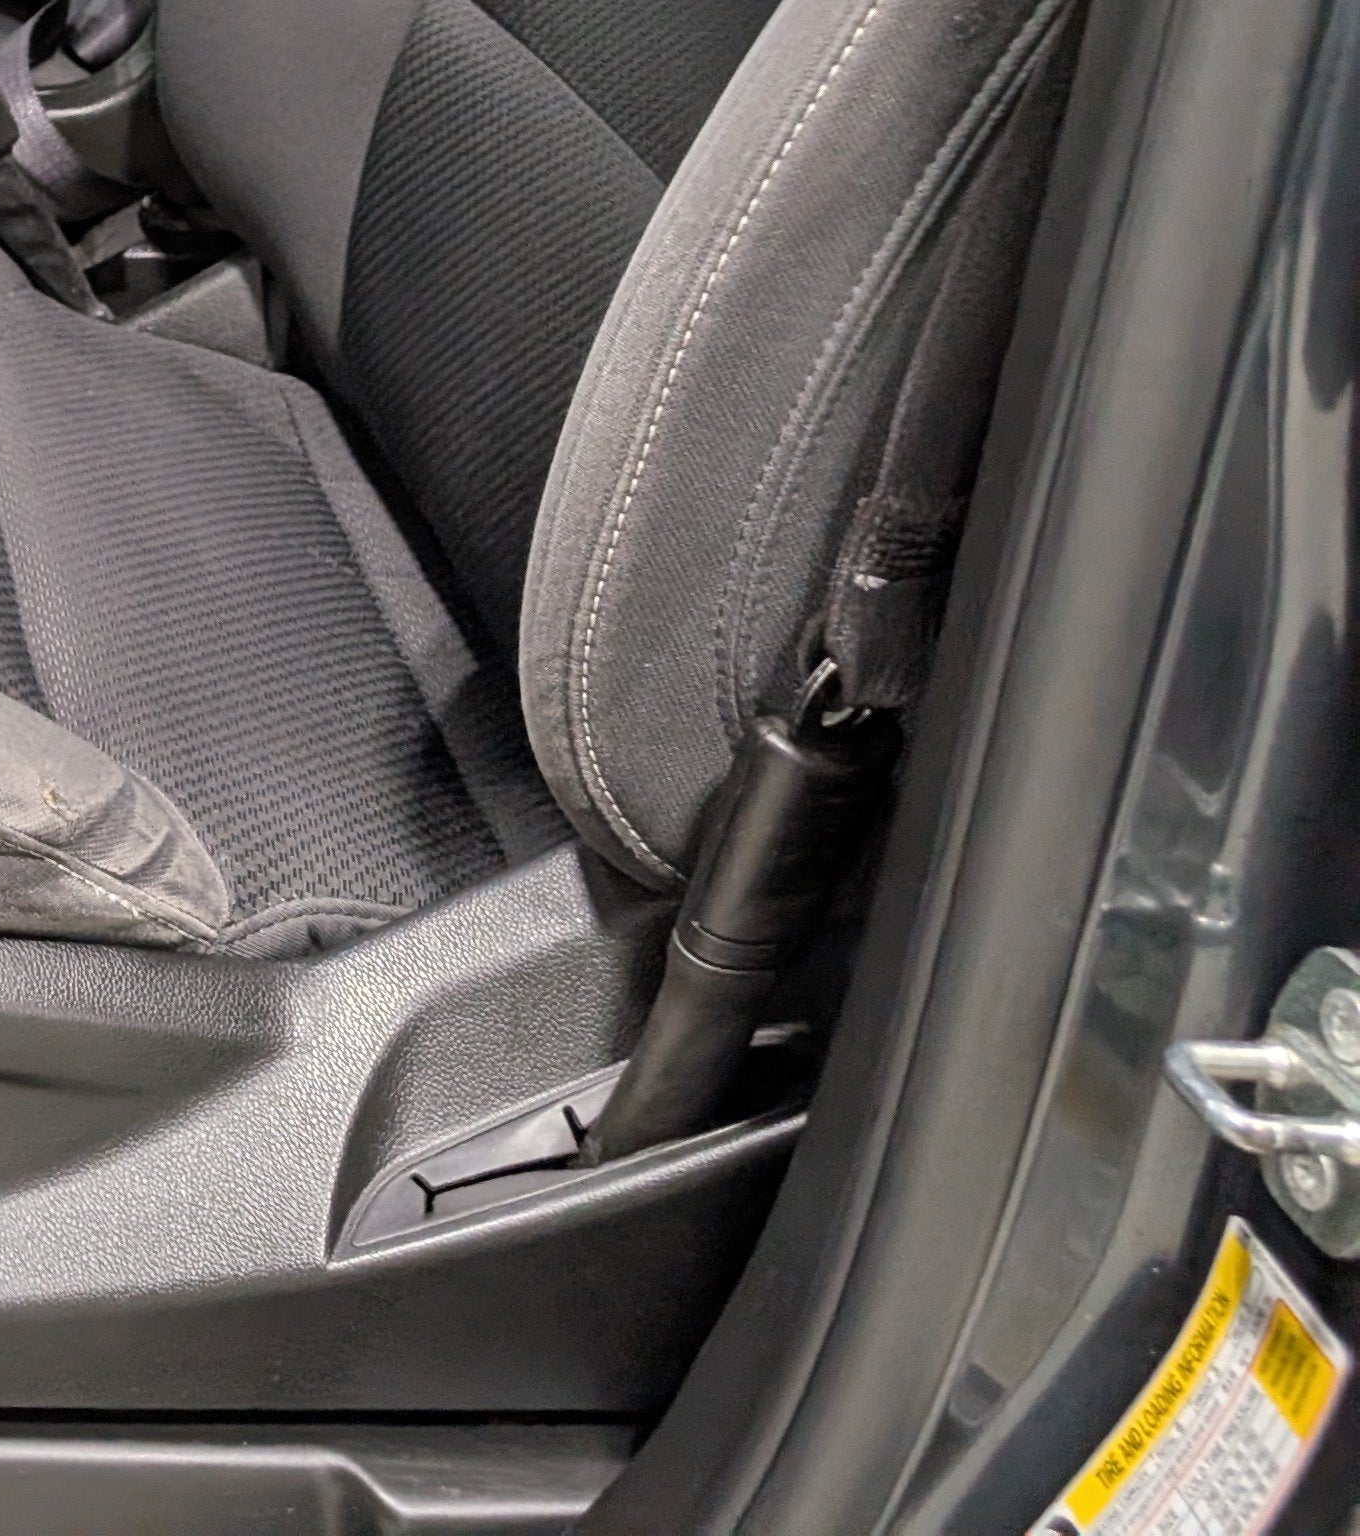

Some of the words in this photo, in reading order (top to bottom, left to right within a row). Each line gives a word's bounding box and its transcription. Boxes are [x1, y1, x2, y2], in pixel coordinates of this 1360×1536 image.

[1095, 1451, 1125, 1489] TIRE
[1118, 1426, 1145, 1461] AND
[1136, 1373, 1184, 1439] LOADING
[1177, 1291, 1231, 1380] INFORMATION
